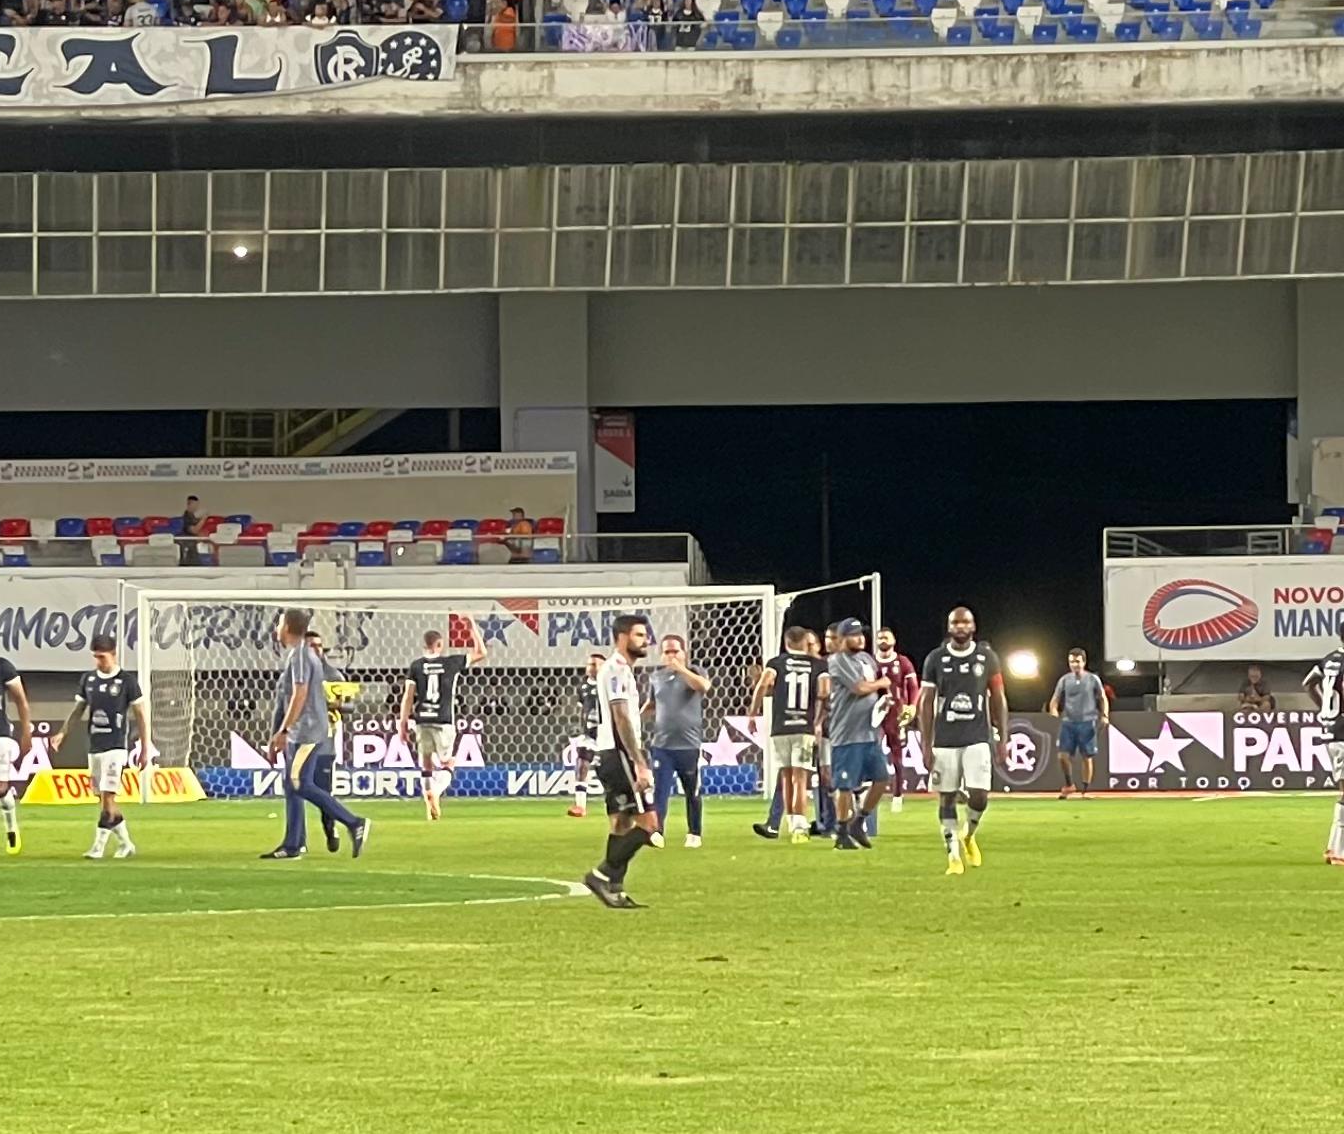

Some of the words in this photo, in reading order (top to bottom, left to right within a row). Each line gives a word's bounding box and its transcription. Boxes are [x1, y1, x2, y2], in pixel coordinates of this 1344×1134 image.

[1274, 587, 1344, 603] NOVO
[427, 674, 440, 703] 4
[785, 671, 809, 710] 11
[456, 718, 484, 730] DO
[353, 733, 485, 768] PAÁ
[332, 771, 422, 796] SORT
[1110, 777, 1158, 788] POR
[1180, 777, 1251, 789] TODO
[1272, 776, 1285, 788] O
